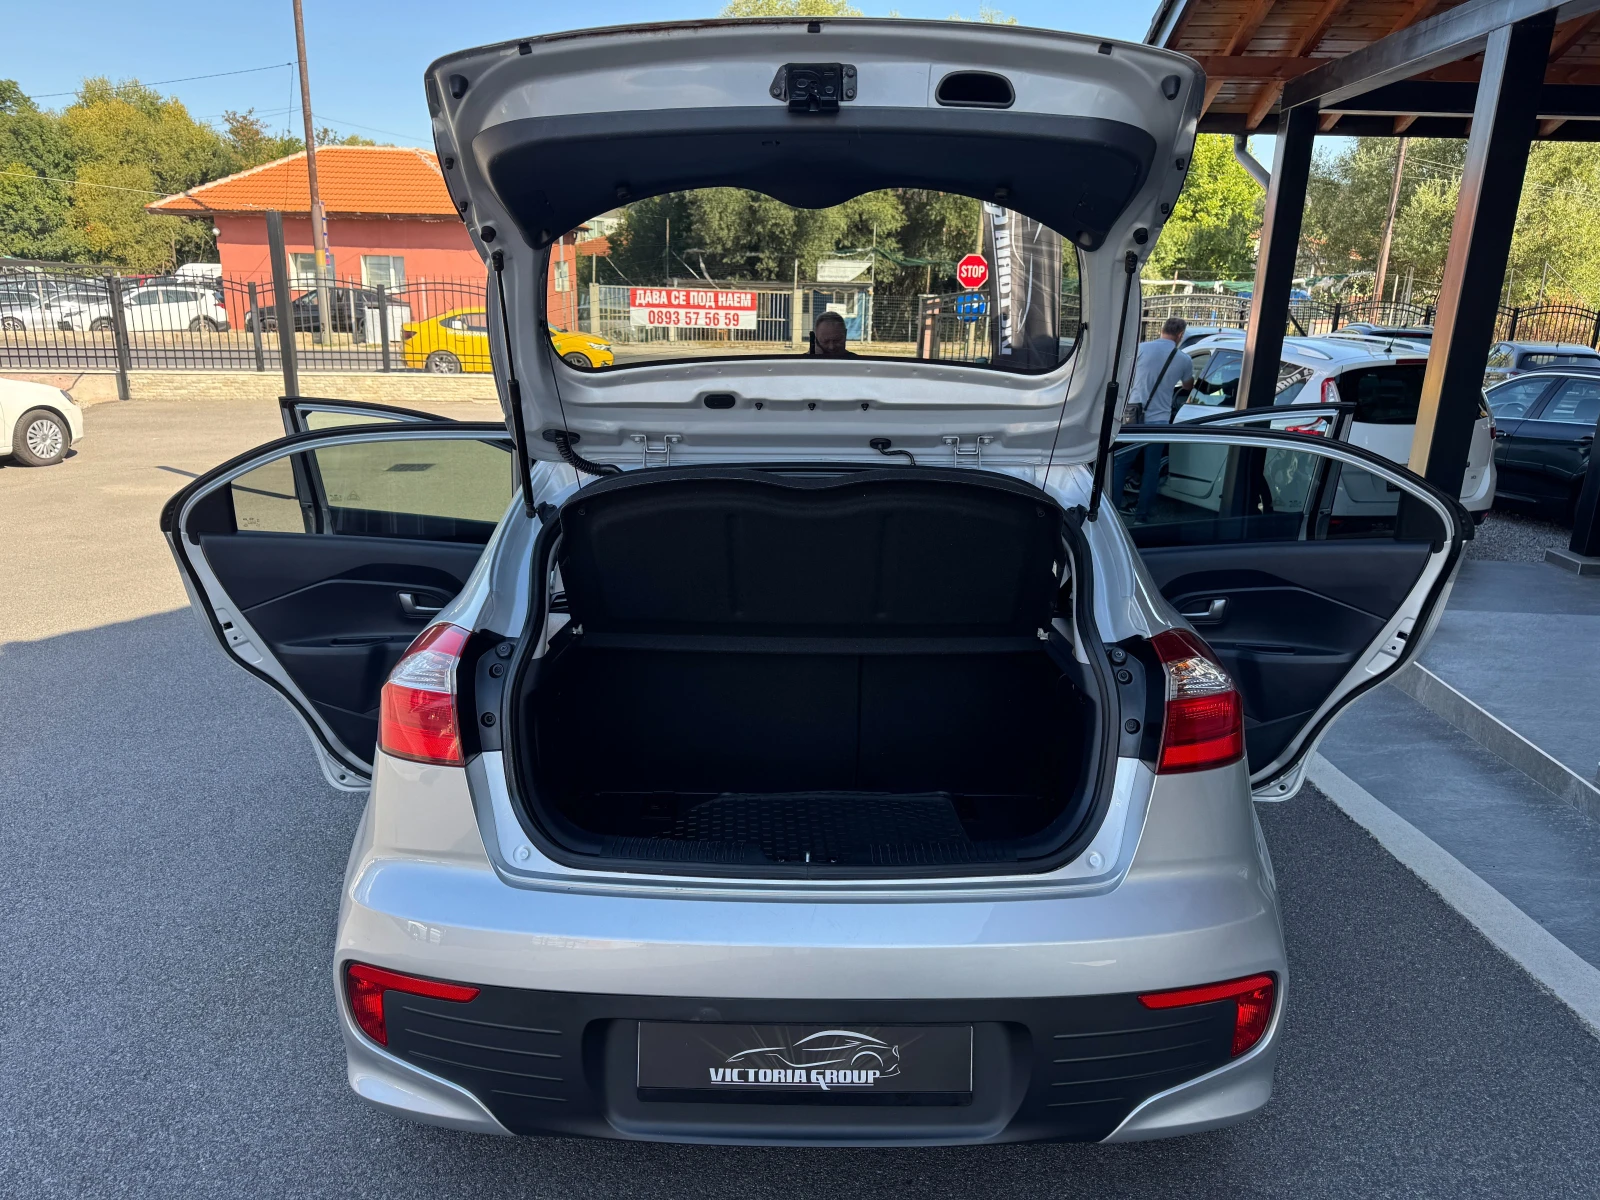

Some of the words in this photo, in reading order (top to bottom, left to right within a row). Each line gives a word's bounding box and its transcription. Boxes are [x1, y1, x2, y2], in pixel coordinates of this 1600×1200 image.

[960, 265, 986, 278] STOP
[636, 290, 668, 307] ДАВА
[671, 291, 686, 305] СЕ
[690, 292, 715, 308] ПОД
[718, 293, 752, 307] НАЕМ
[648, 310, 680, 325] 0893
[685, 311, 700, 326] 57
[705, 312, 720, 326] 56
[724, 312, 739, 327] 59
[709, 1068, 808, 1083] VICTORIA
[811, 1069, 881, 1091] GROUP
